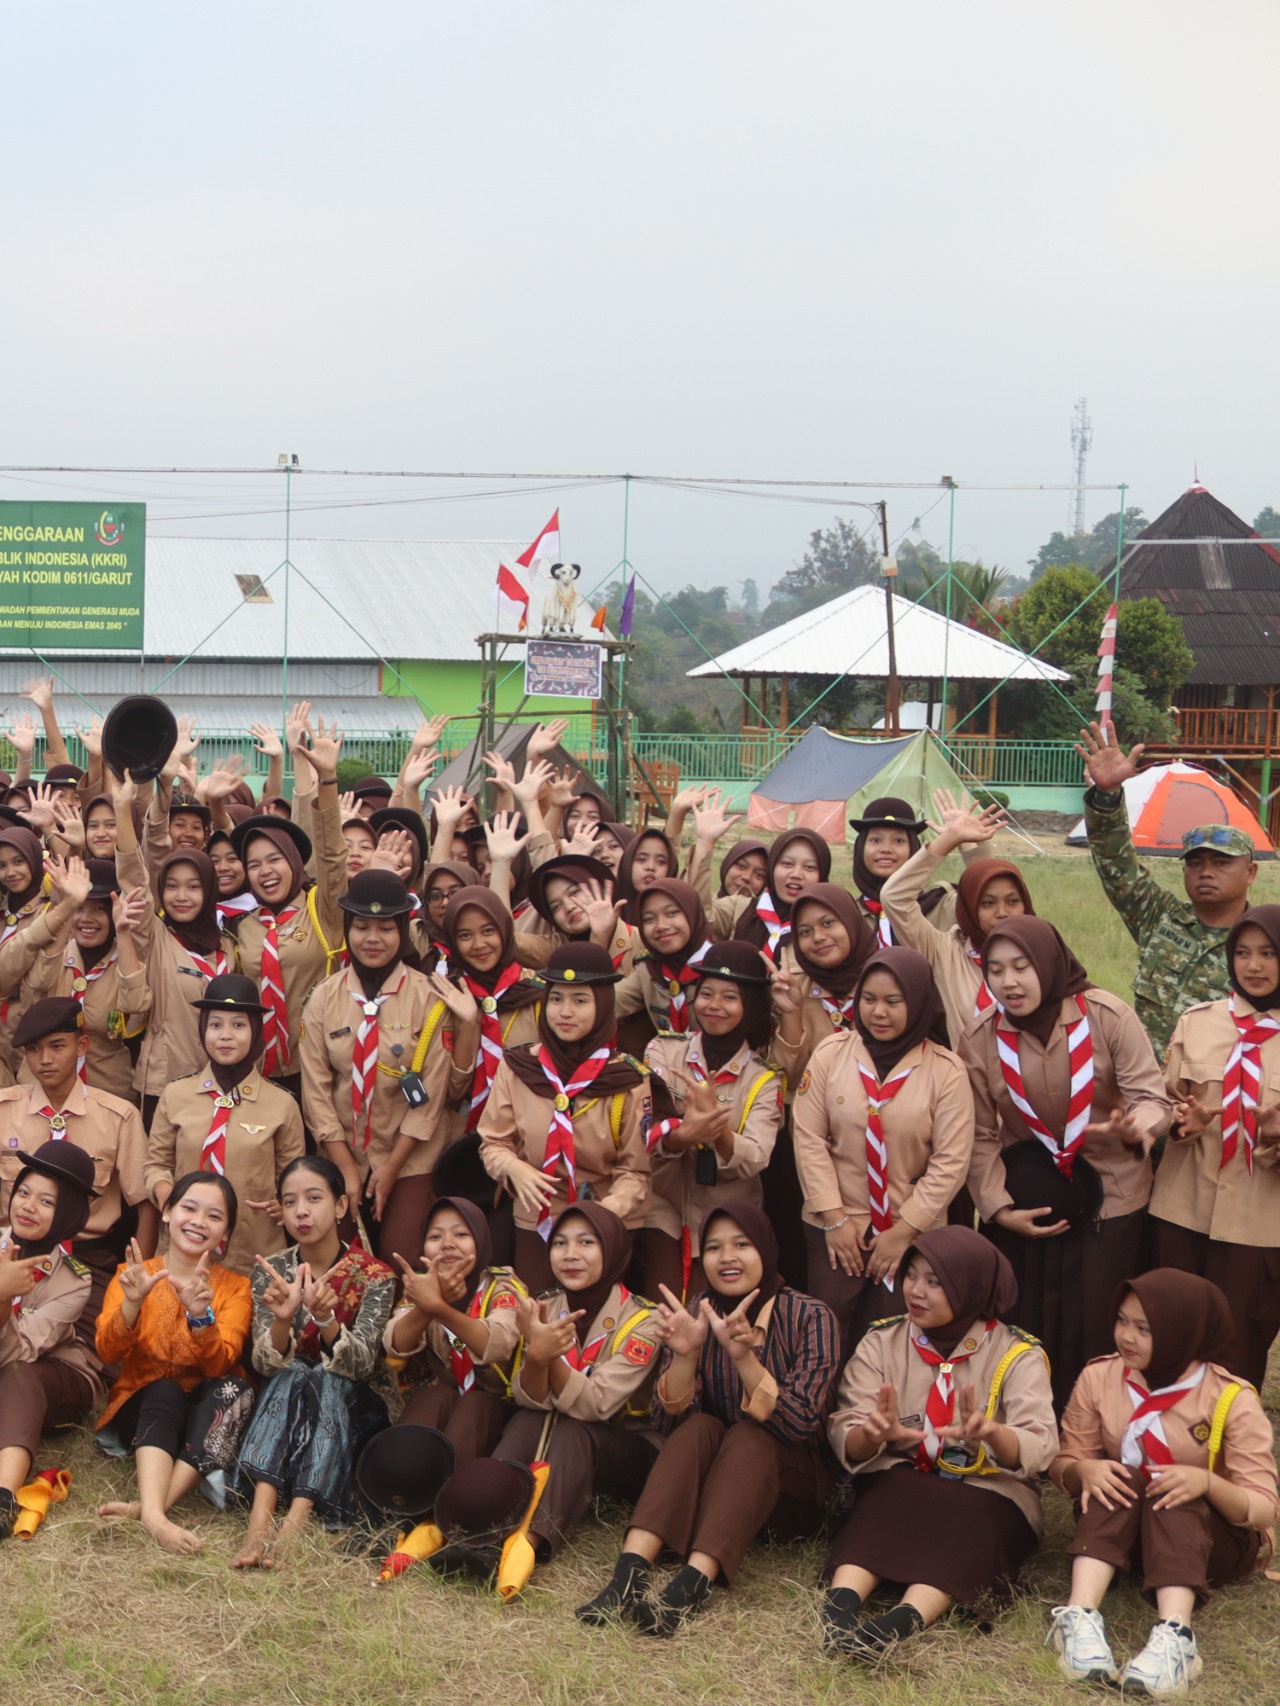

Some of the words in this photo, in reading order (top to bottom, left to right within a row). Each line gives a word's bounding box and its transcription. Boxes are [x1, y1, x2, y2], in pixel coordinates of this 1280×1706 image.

[25, 552, 89, 565] INDONESIA
[91, 553, 128, 568] (KKRI)
[22, 571, 60, 583] KODIM
[64, 572, 133, 585] 0611/GARUT
[26, 606, 80, 614] PEMBENTUKAN
[82, 607, 118, 615] GENERASI
[14, 620, 44, 628] MENUJU
[44, 621, 84, 629] INDONESIA
[84, 621, 105, 629] EMAS
